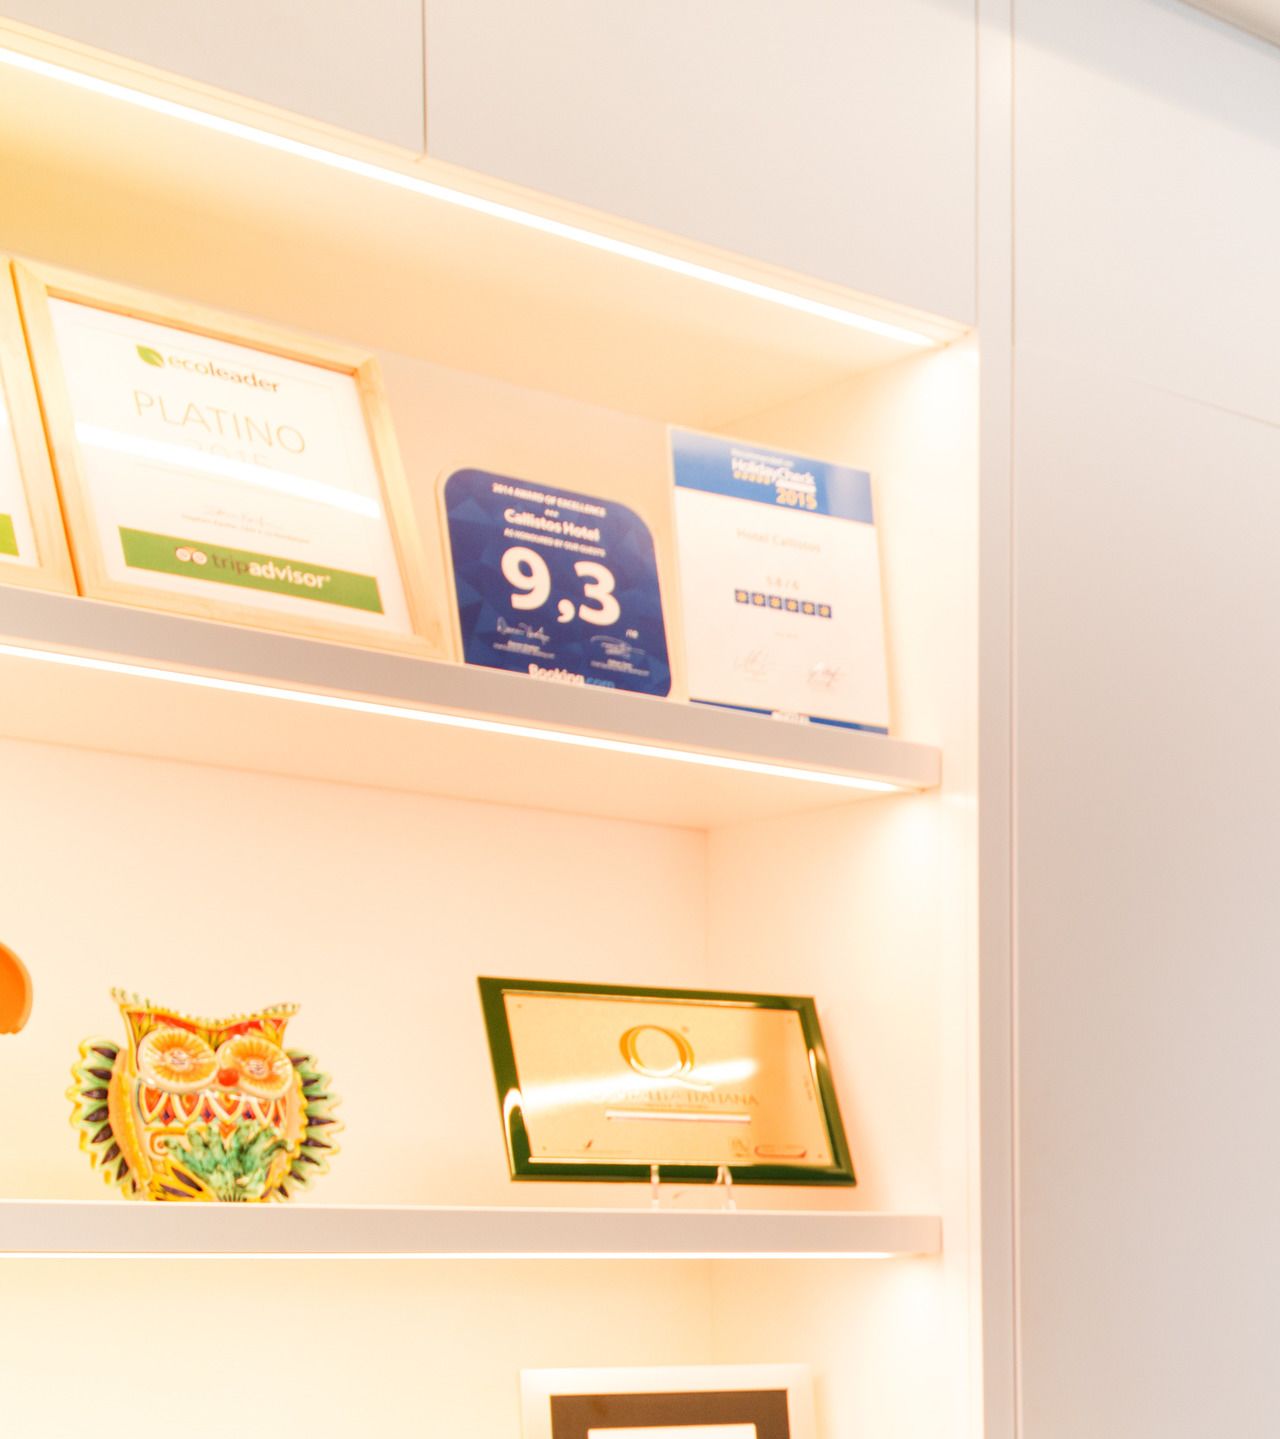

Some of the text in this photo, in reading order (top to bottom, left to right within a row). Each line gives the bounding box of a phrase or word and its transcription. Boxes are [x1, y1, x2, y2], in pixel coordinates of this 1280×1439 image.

[168, 354, 281, 394] ecoleader
[132, 389, 306, 455] PLATINO
[562, 521, 601, 543] Hotel
[212, 552, 329, 590] tripadvisor
[500, 545, 622, 626] 9,3
